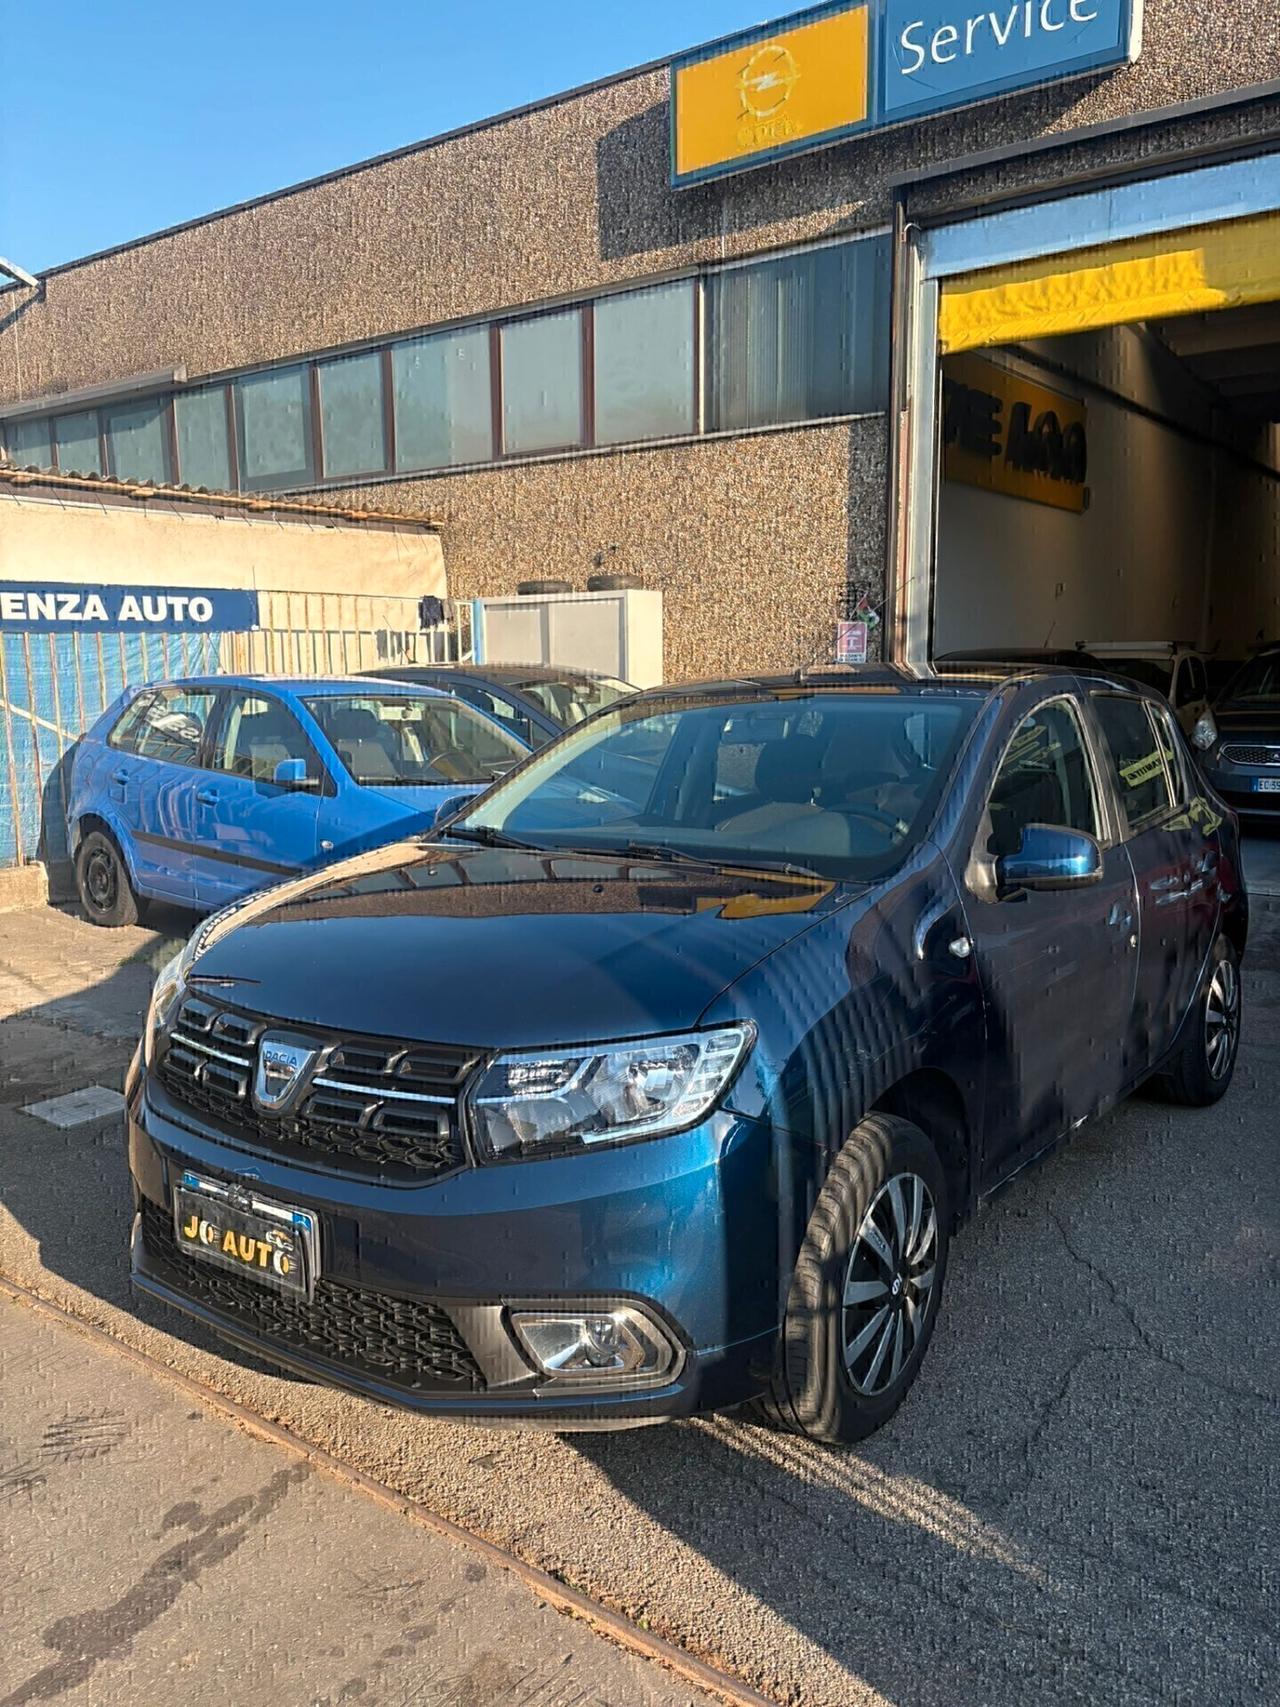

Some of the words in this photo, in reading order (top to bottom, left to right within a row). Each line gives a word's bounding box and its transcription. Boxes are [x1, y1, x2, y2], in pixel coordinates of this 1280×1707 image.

[901, 0, 1097, 75] Service
[0, 592, 109, 621] ENZA
[118, 595, 214, 623] AUTO
[264, 1050, 298, 1067] DACIA
[222, 1230, 291, 1276] AUTO
